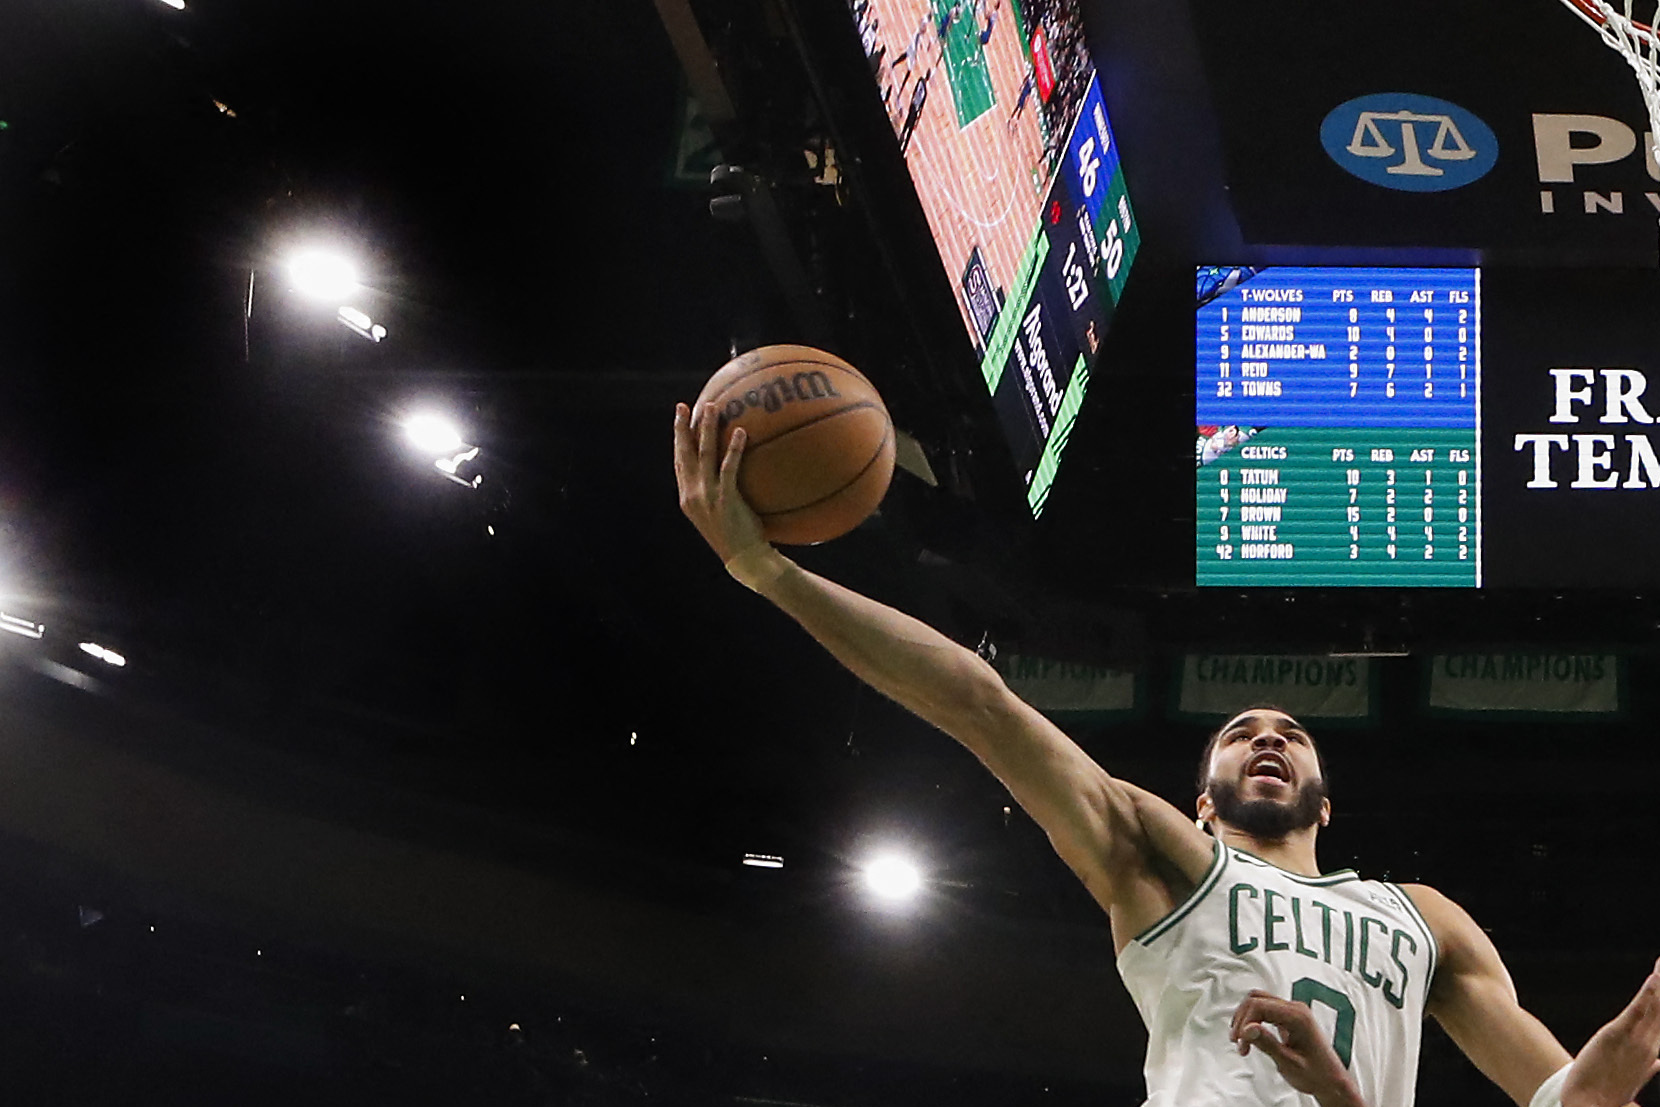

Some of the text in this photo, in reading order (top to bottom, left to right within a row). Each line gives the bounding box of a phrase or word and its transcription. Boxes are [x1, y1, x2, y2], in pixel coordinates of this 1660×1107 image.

[1079, 136, 1099, 197] 46
[1101, 218, 1124, 280] 50
[1063, 241, 1088, 311] 1:27
[1241, 288, 1469, 304] T-WOLVES PTS REB AST FLS
[1241, 306, 1468, 324] ANDERSON 4 4 2
[1220, 324, 1395, 343] 5 EDWARDS 10 4
[1022, 303, 1064, 416] Algorand
[1220, 343, 1468, 362] 9 ALEXANDER-WA 2 2
[1219, 362, 1396, 379] 11 REID 9 7
[1216, 380, 1433, 399] 32 TOWNS 7 6 2
[1241, 446, 1470, 463] CELTICS PTS REB AST FLS
[1239, 468, 1396, 486] TATUM 10 3
[1220, 487, 1467, 505] 4 HOLIDAY 7 2 2 2
[1219, 506, 1396, 523] 7 BROWN 15 2
[1241, 525, 1467, 542] WHITE 4 4 4 2
[1216, 543, 1468, 560] 42 HORFORD 3 4 2 2
[1198, 659, 1357, 687] CHAMPIONS
[1444, 655, 1606, 682] CHAMPIONS
[1229, 882, 1417, 1010] CELTICS
